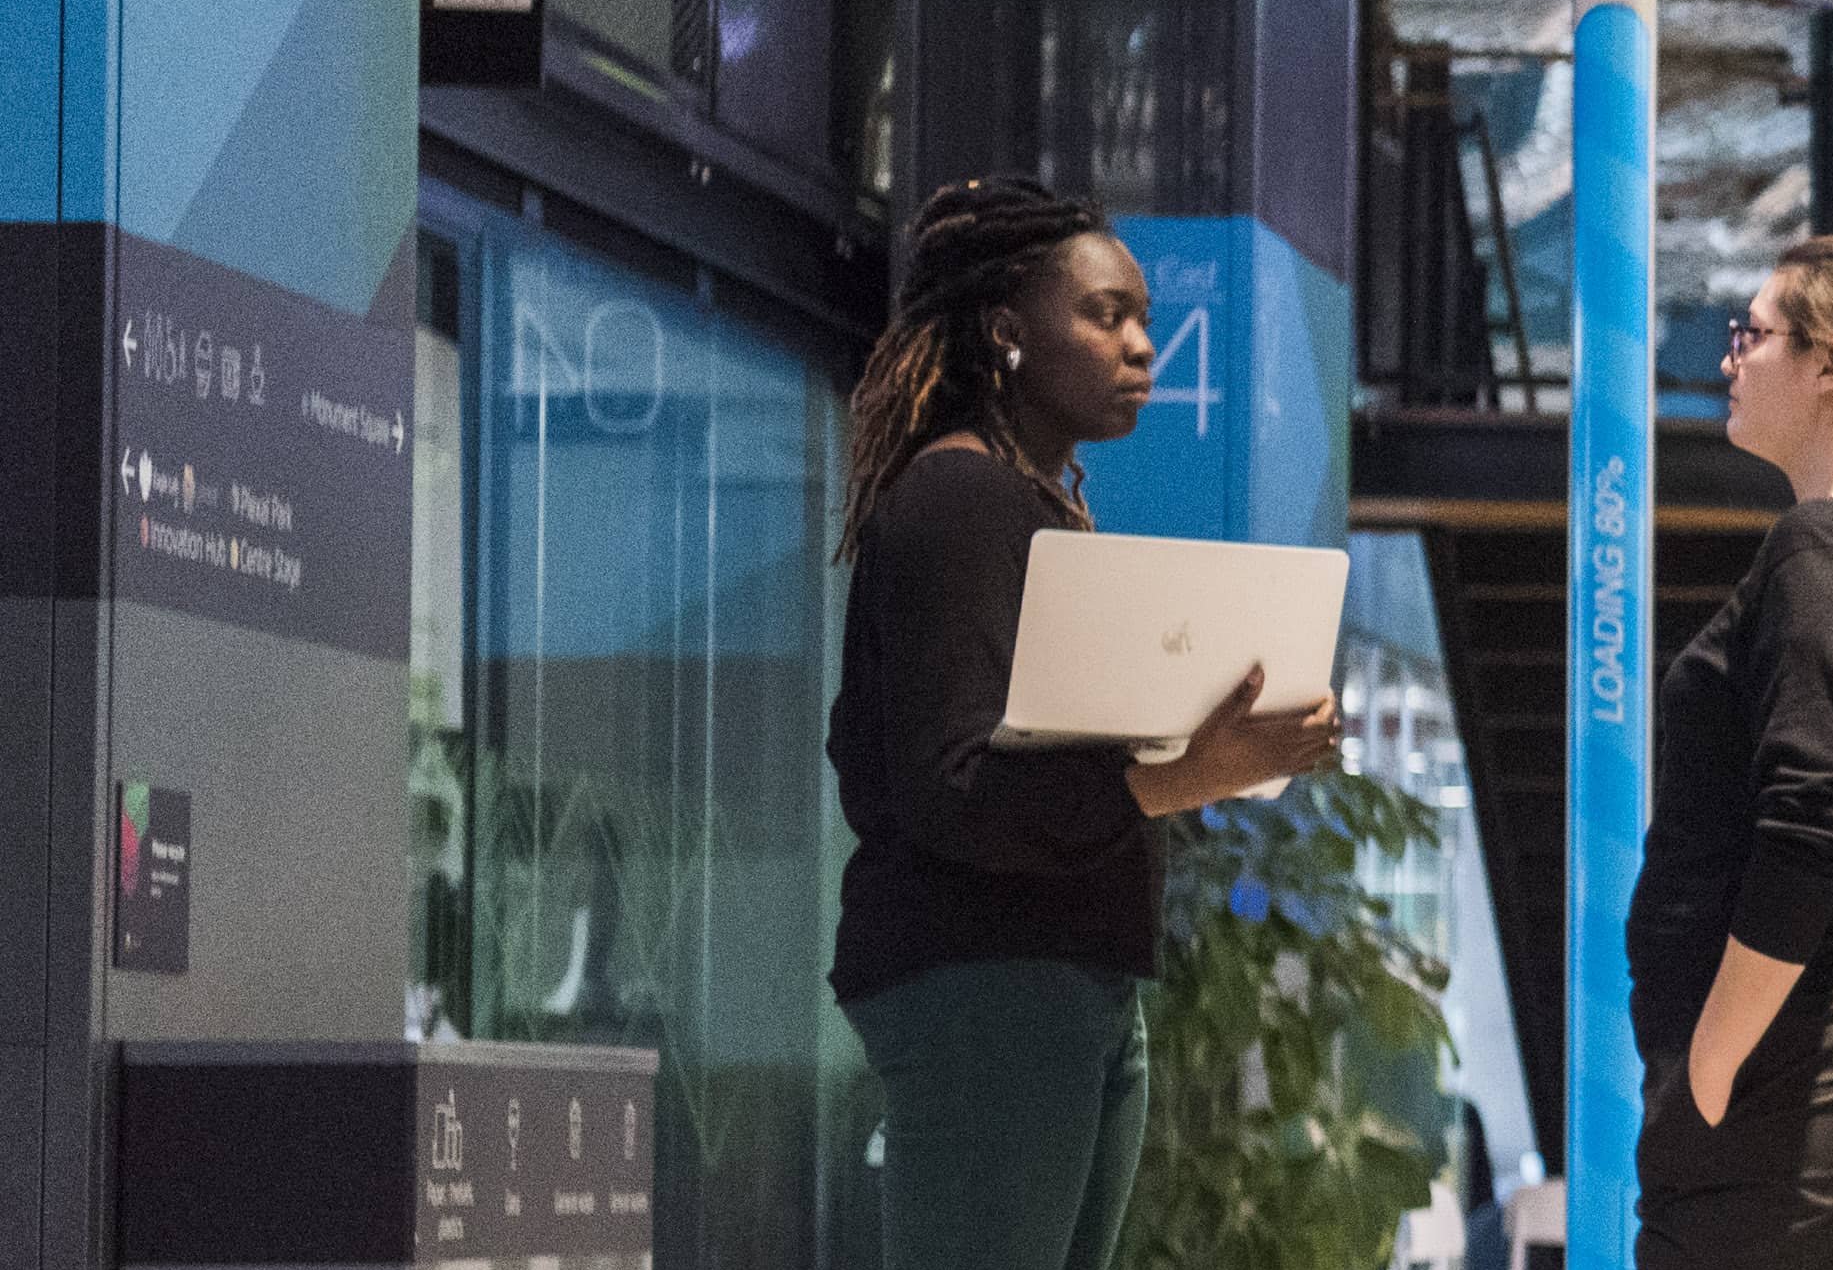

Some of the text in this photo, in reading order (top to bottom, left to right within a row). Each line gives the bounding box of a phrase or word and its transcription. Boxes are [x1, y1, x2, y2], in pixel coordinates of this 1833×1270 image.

[151, 519, 203, 562] Innovation
[206, 531, 226, 568] Hub
[1592, 455, 1625, 724] LOADING 80%
